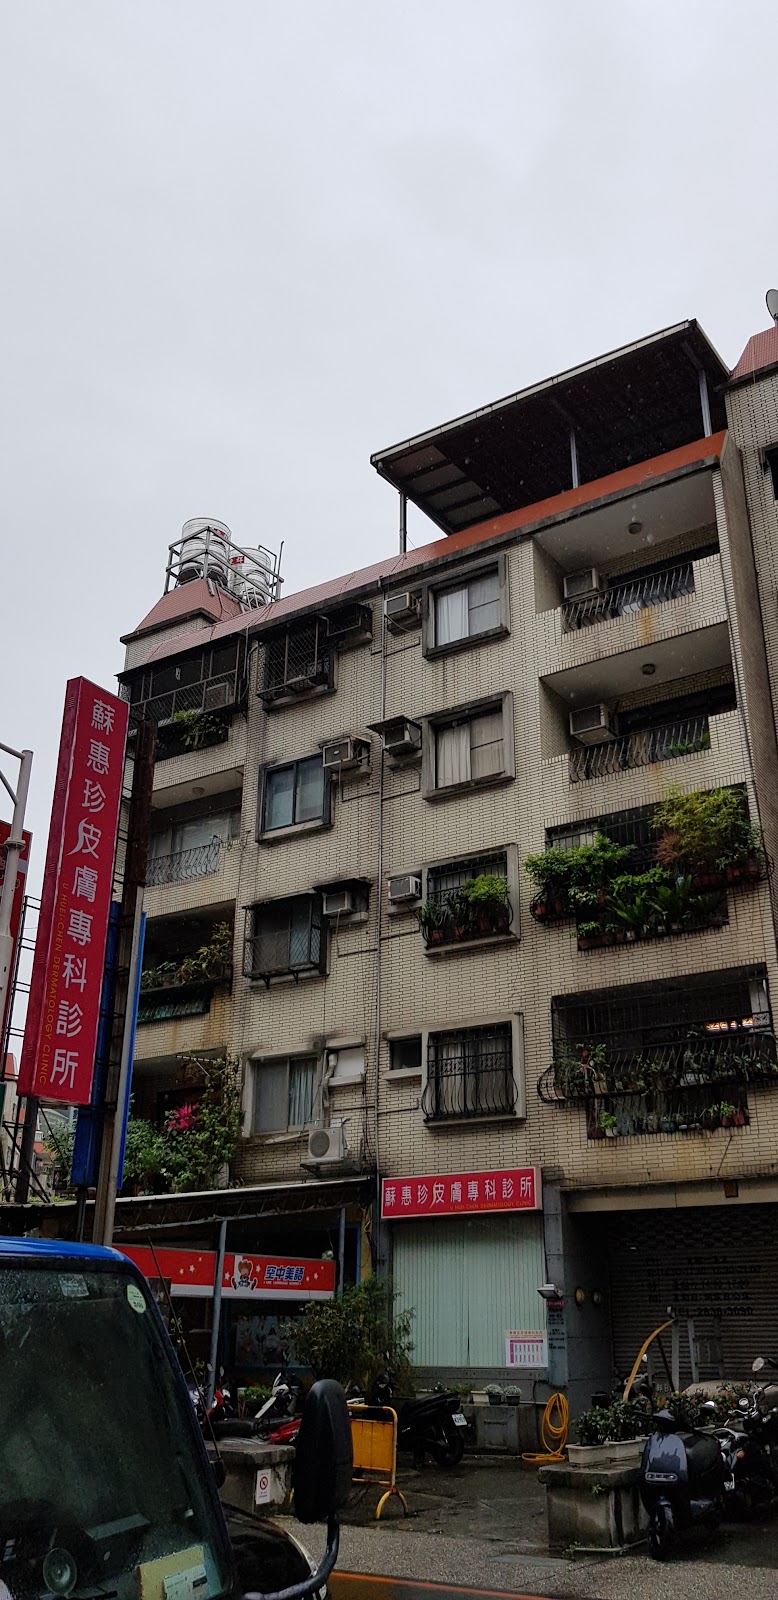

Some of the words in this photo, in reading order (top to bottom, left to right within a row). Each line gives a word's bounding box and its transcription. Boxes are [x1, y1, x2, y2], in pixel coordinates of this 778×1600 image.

[50, 698, 115, 1088] 蘇惠珍皮膚專科診所
[53, 894, 69, 952] HUEI-CHEN
[44, 956, 61, 1040] DERMATOLOGY
[40, 1044, 51, 1084] CLINIC
[385, 1176, 532, 1208] 蘇惠珍皮膚專科診所
[264, 1265, 305, 1282] 空中美語
